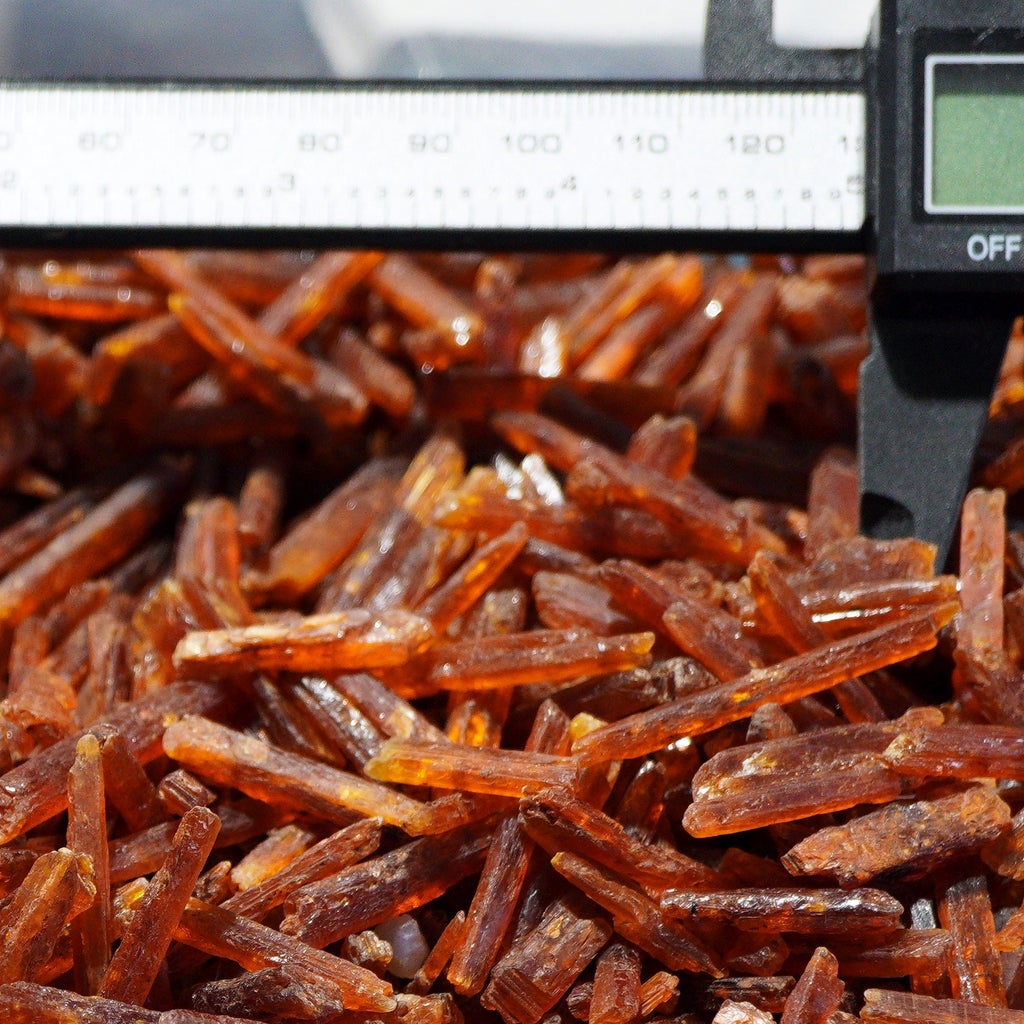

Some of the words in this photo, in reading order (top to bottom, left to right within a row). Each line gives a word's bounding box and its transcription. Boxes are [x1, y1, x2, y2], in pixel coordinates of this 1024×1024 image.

[77, 130, 123, 152] 60
[188, 131, 233, 153] 70
[297, 132, 342, 153] 80
[408, 132, 453, 154] 90
[500, 132, 563, 155] 100
[612, 133, 670, 156] 110
[724, 133, 787, 156] 120
[277, 171, 294, 192] 3
[966, 233, 1021, 262] OFF
